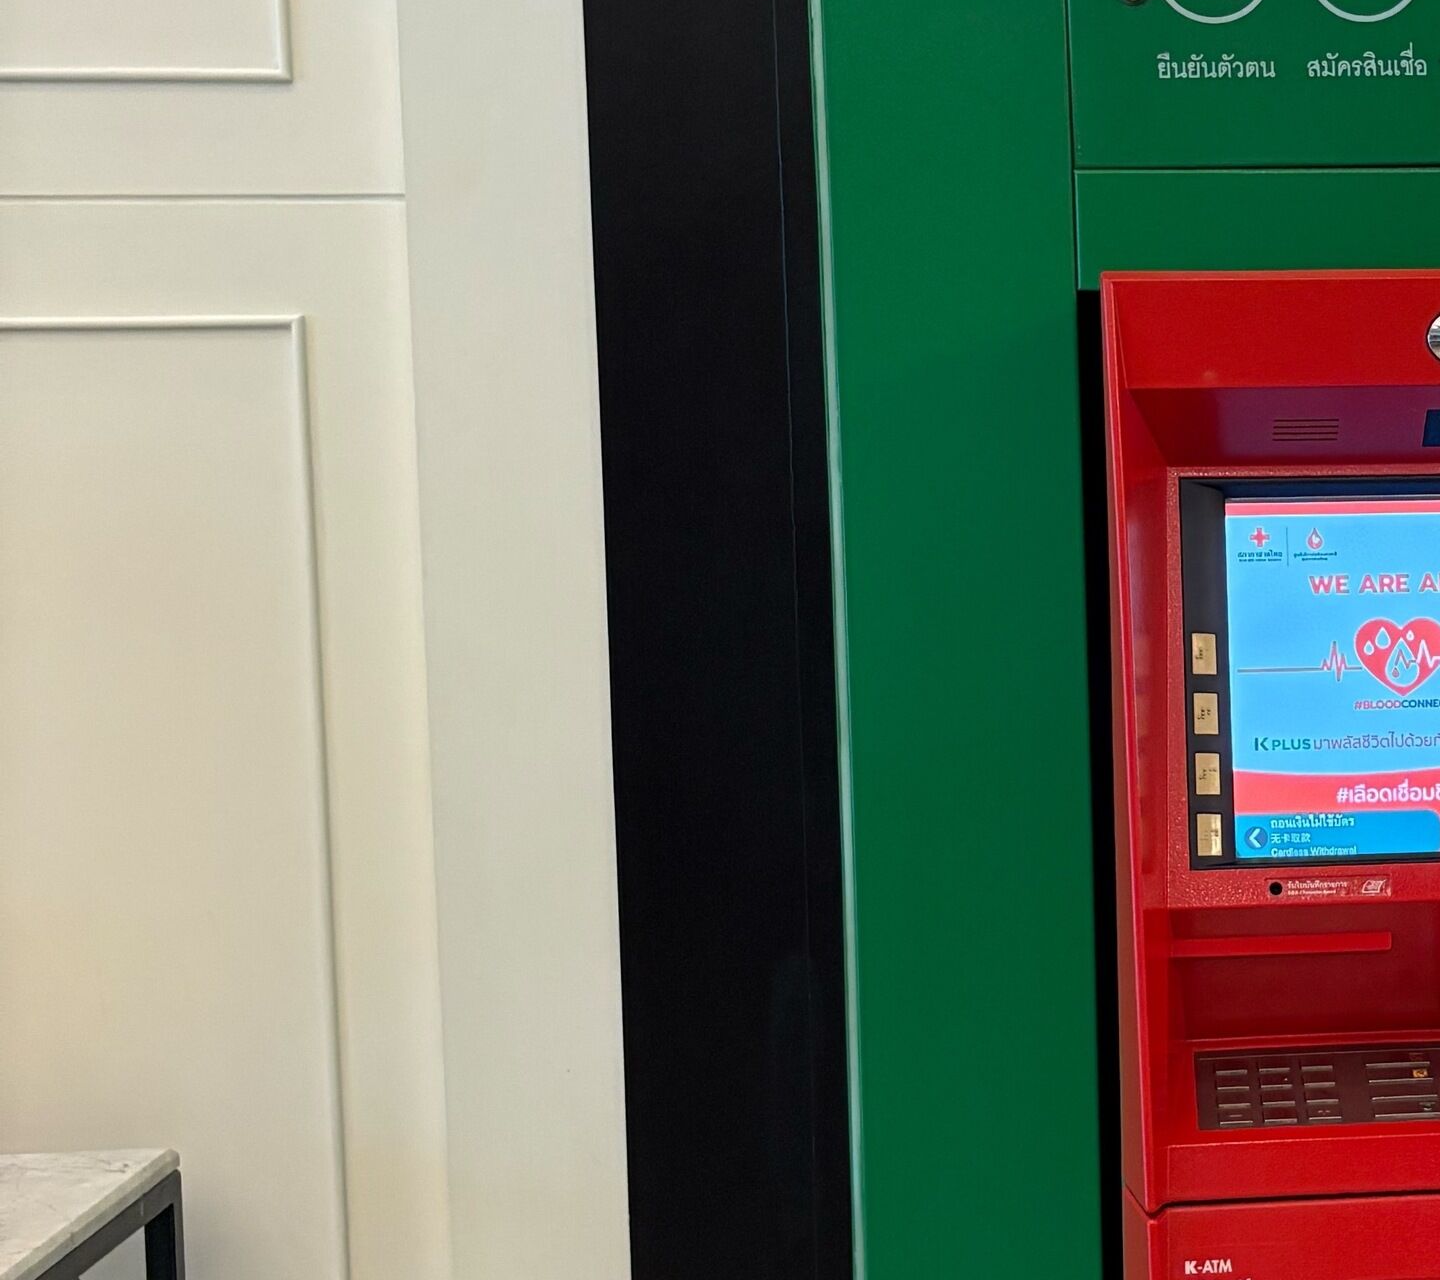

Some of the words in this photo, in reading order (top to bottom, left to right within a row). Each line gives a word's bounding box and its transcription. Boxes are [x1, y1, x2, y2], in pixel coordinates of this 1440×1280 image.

[1157, 51, 1276, 79] ยืนยันตัวตน
[1307, 42, 1427, 78] สมัครสินเชื่อ
[1309, 573, 1350, 595] WE
[1358, 572, 1410, 594] ARE
[1271, 736, 1311, 751] PLUS
[1184, 1258, 1233, 1275] K-ATM
